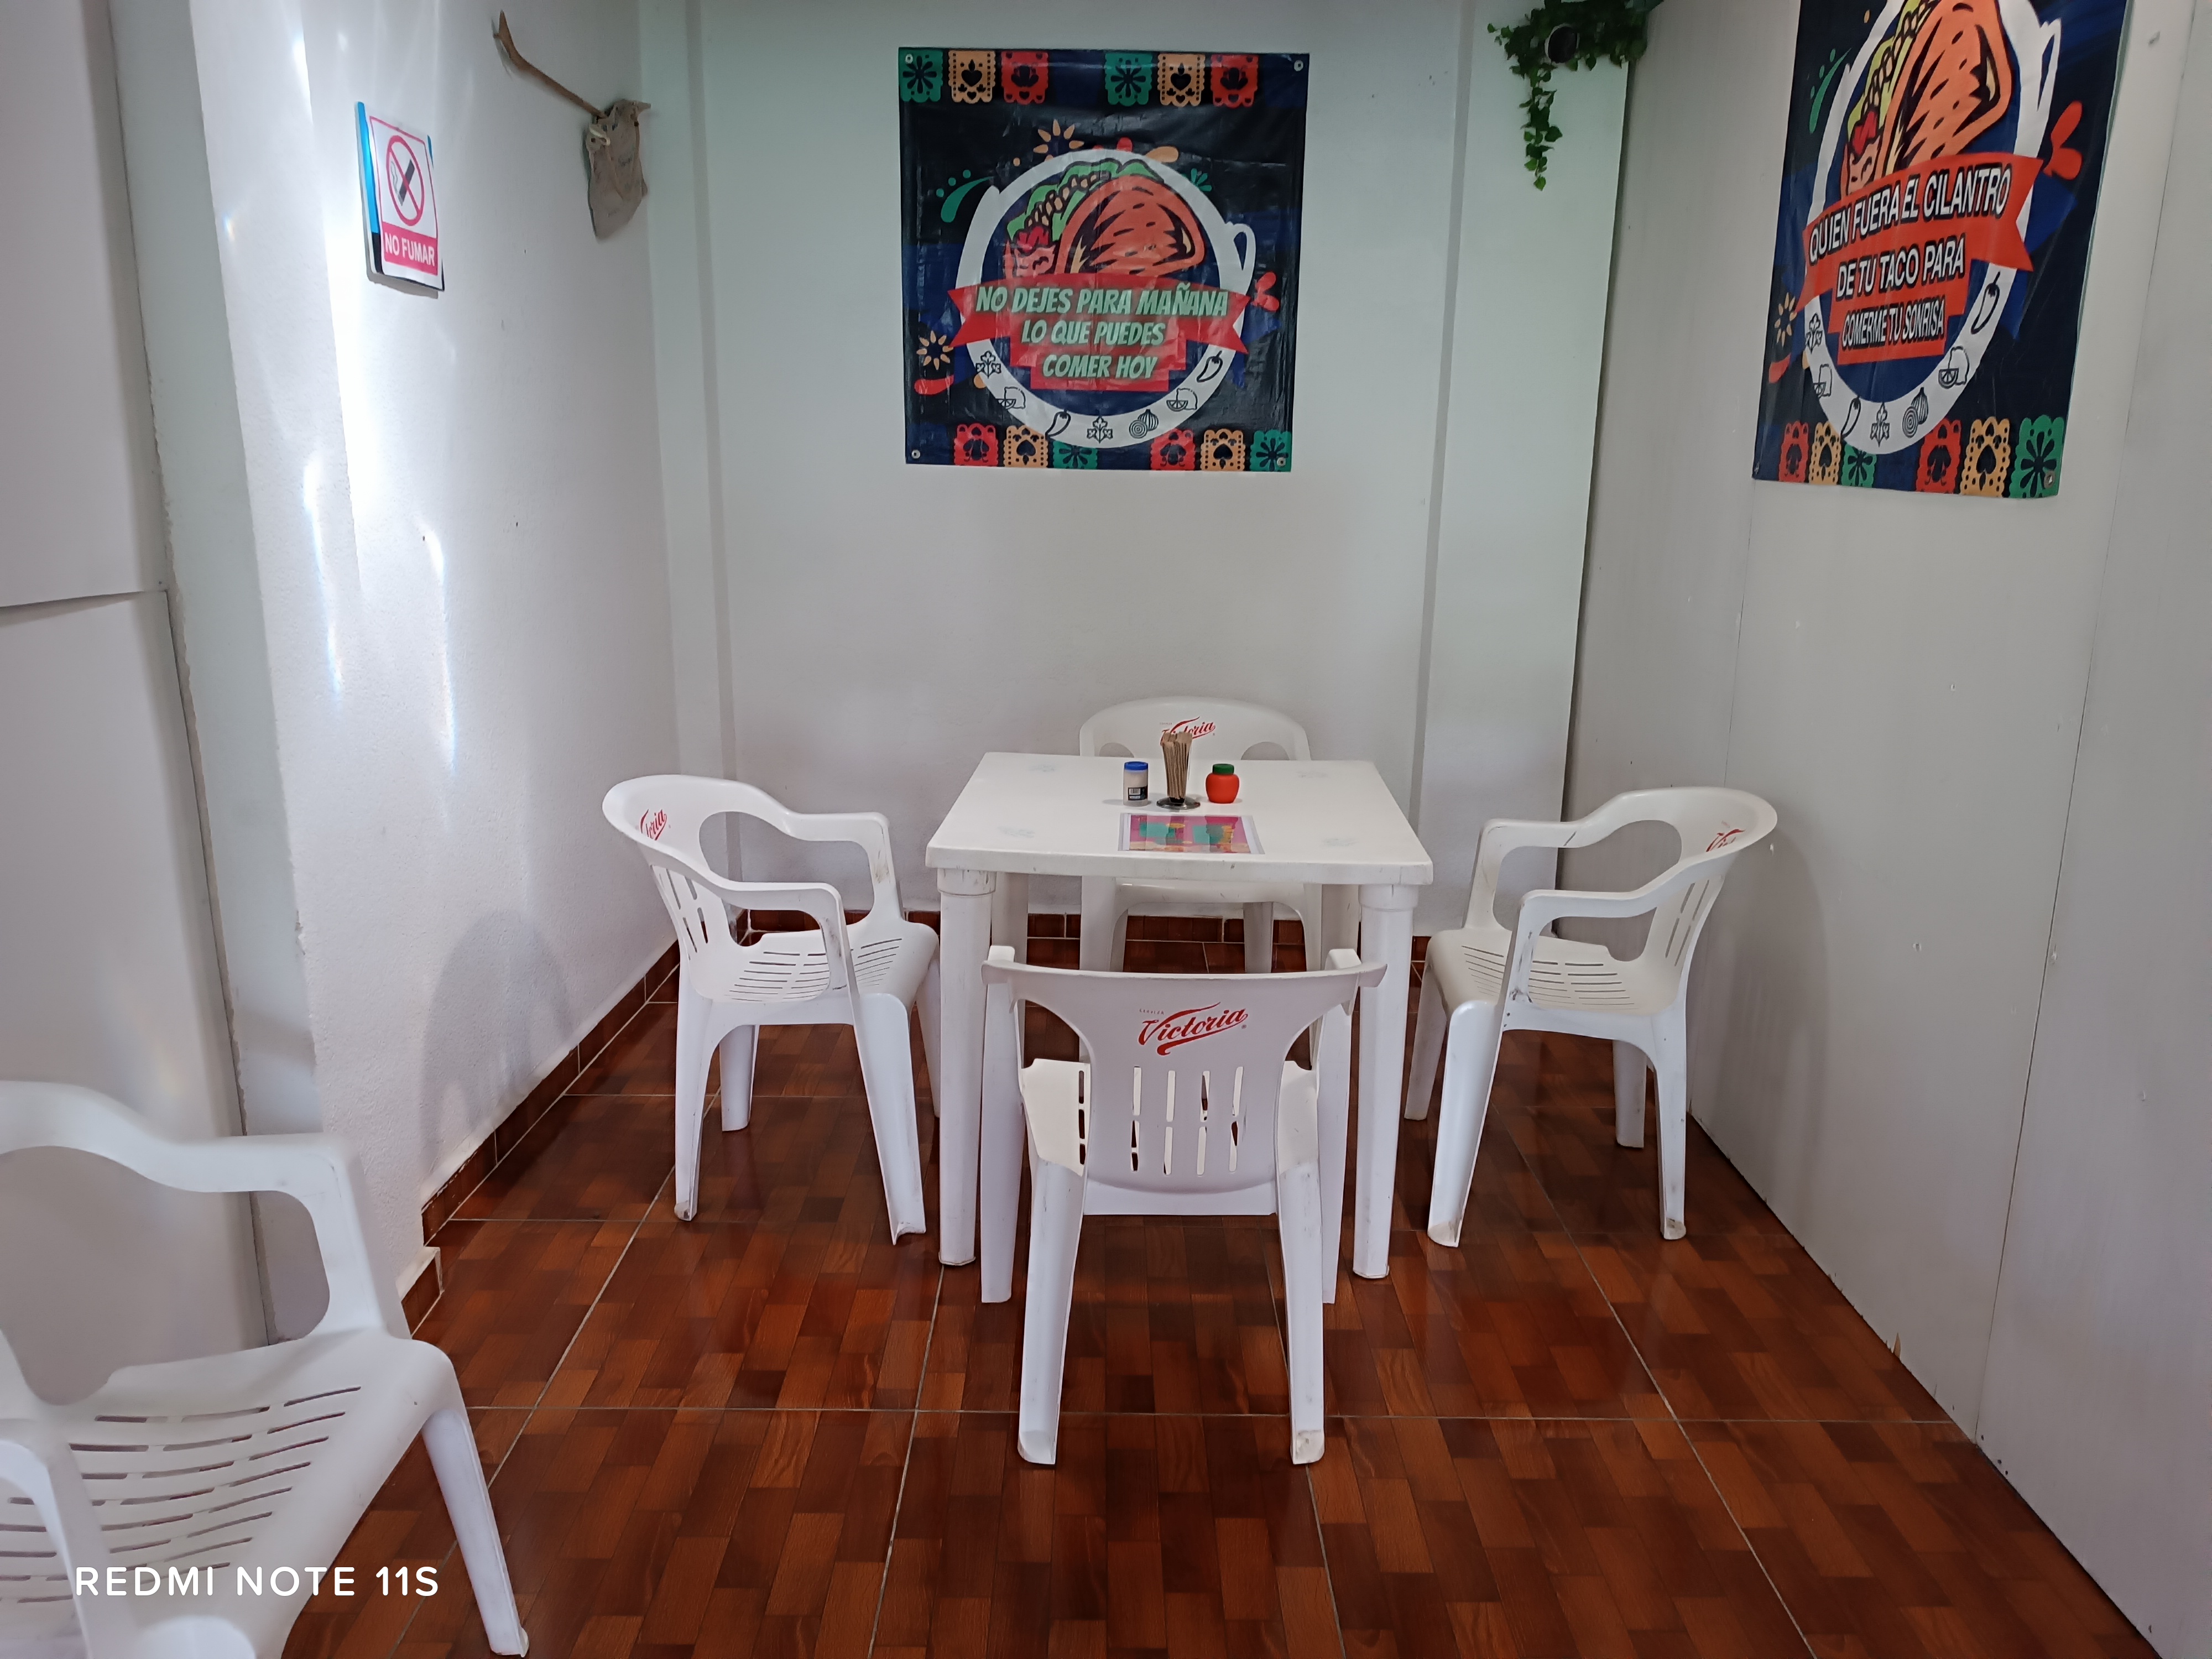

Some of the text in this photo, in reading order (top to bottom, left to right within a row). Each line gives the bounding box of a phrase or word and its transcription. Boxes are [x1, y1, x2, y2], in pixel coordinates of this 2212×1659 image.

[1809, 166, 2012, 263] QUIEN FUERA EL CILANTRO
[385, 233, 435, 266] NO FUMAR
[1835, 237, 1965, 300] DE TU TACO PARA
[976, 283, 1229, 317] NO DEJES PARA MAÑANA
[1021, 319, 1166, 346] LO QUE PUEDES
[1841, 299, 1945, 348] COMERME TU SONRISA
[1042, 354, 1158, 379] COMER HOY
[1138, 1001, 1248, 1056] Victoria
